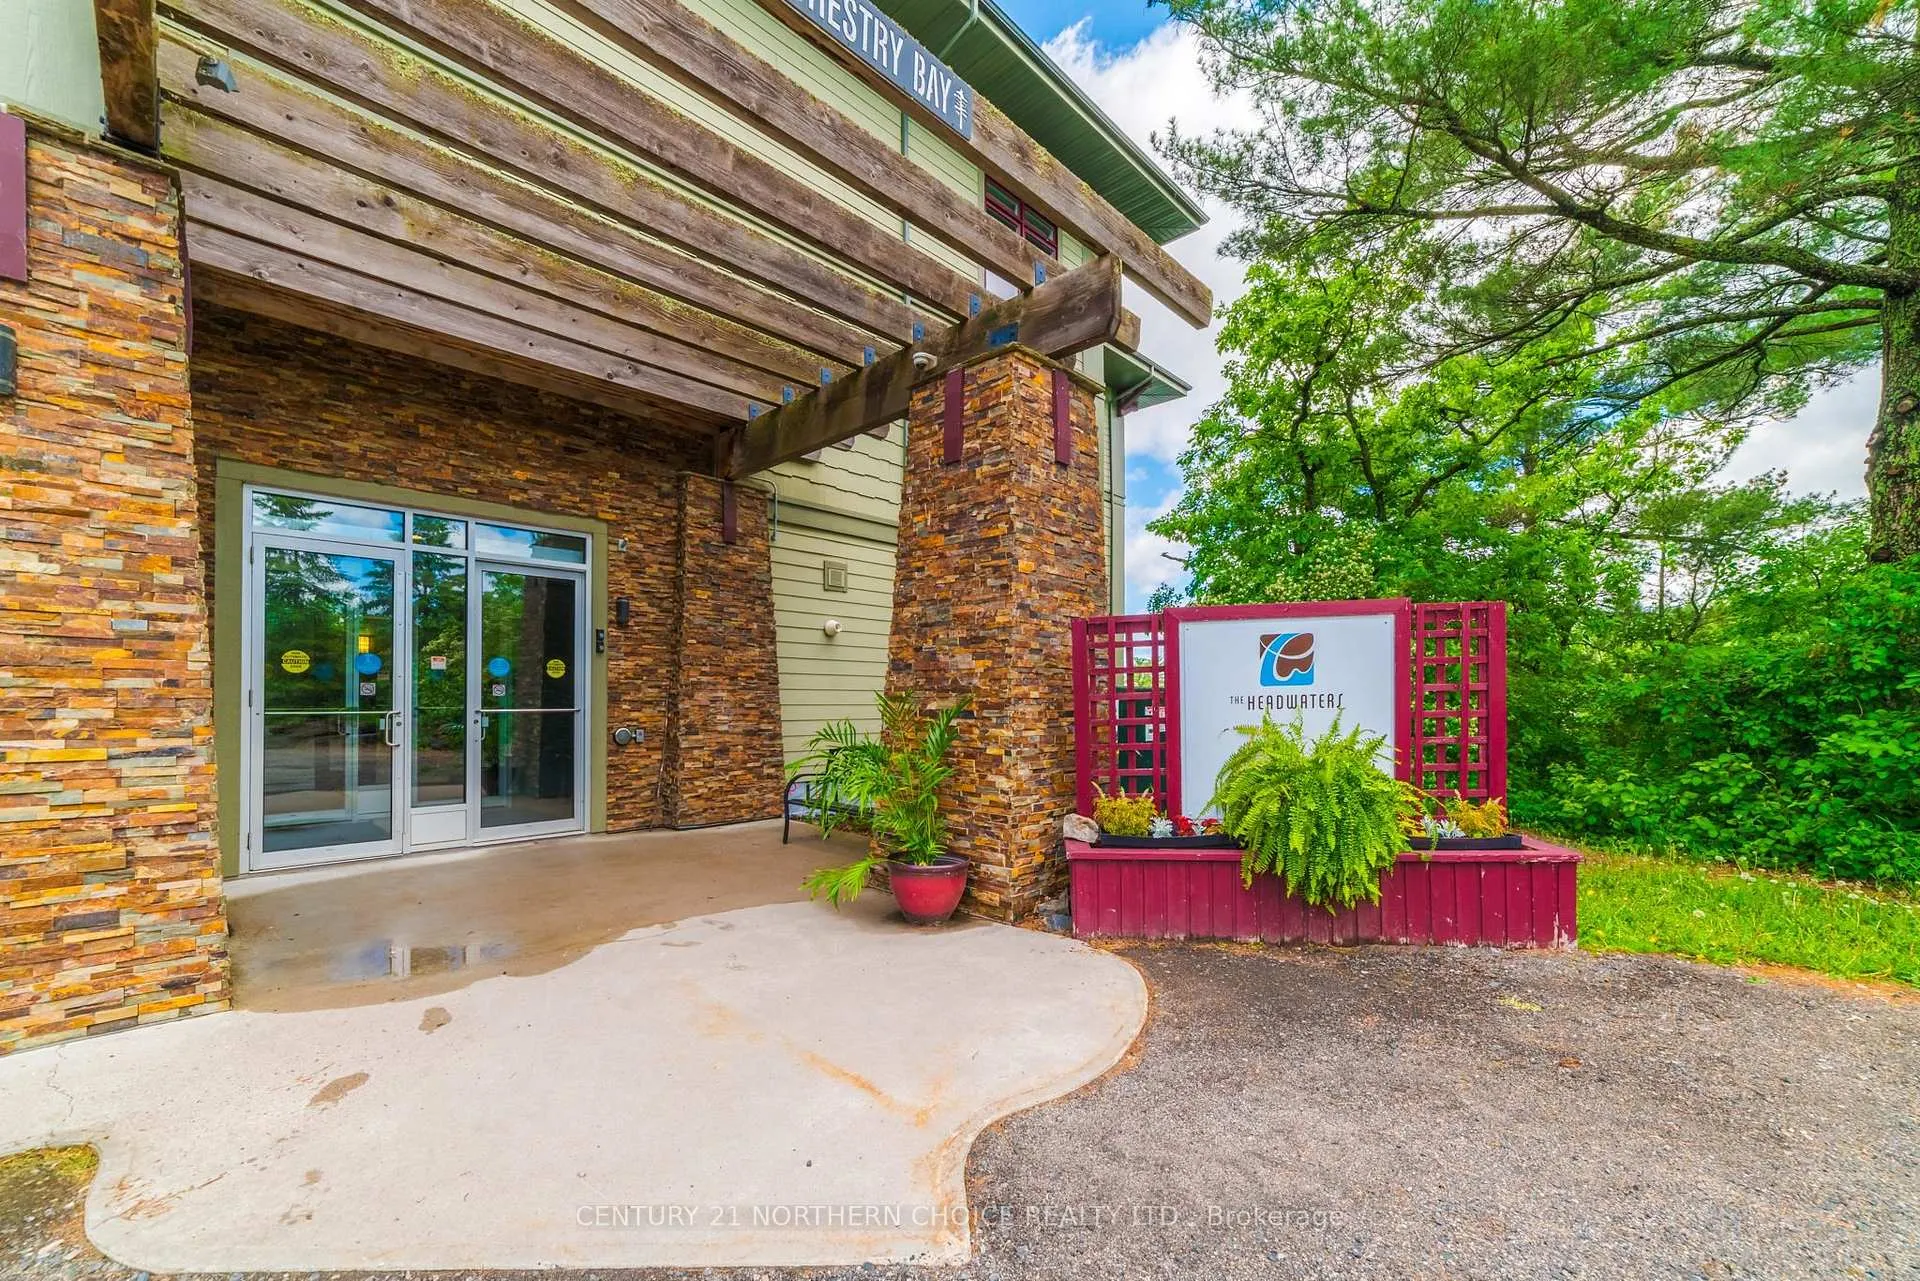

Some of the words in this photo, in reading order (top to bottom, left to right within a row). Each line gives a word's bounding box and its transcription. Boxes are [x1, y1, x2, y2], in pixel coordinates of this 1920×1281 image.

[808, 0, 903, 76] ESTRY
[913, 51, 952, 114] BAY
[1230, 695, 1244, 705] THE
[1247, 693, 1344, 711] HEADWATERS
